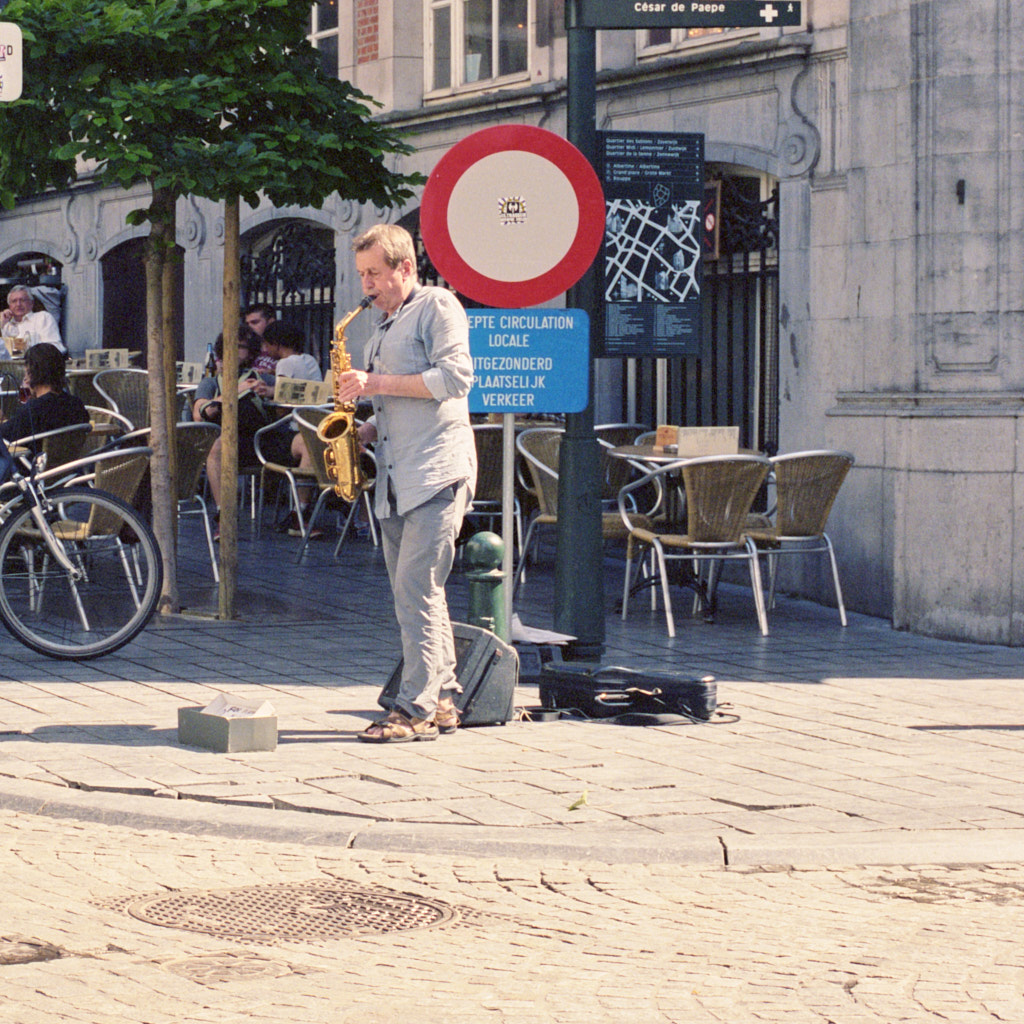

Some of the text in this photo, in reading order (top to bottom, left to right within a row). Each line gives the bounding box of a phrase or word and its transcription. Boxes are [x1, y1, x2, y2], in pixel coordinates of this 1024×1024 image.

[634, 2, 726, 15] César de Paepe
[499, 315, 574, 330] CIRCULATION
[488, 334, 530, 347] LOCALE
[471, 375, 546, 389] PLAATSELIJK
[482, 393, 535, 407] VERKEER
